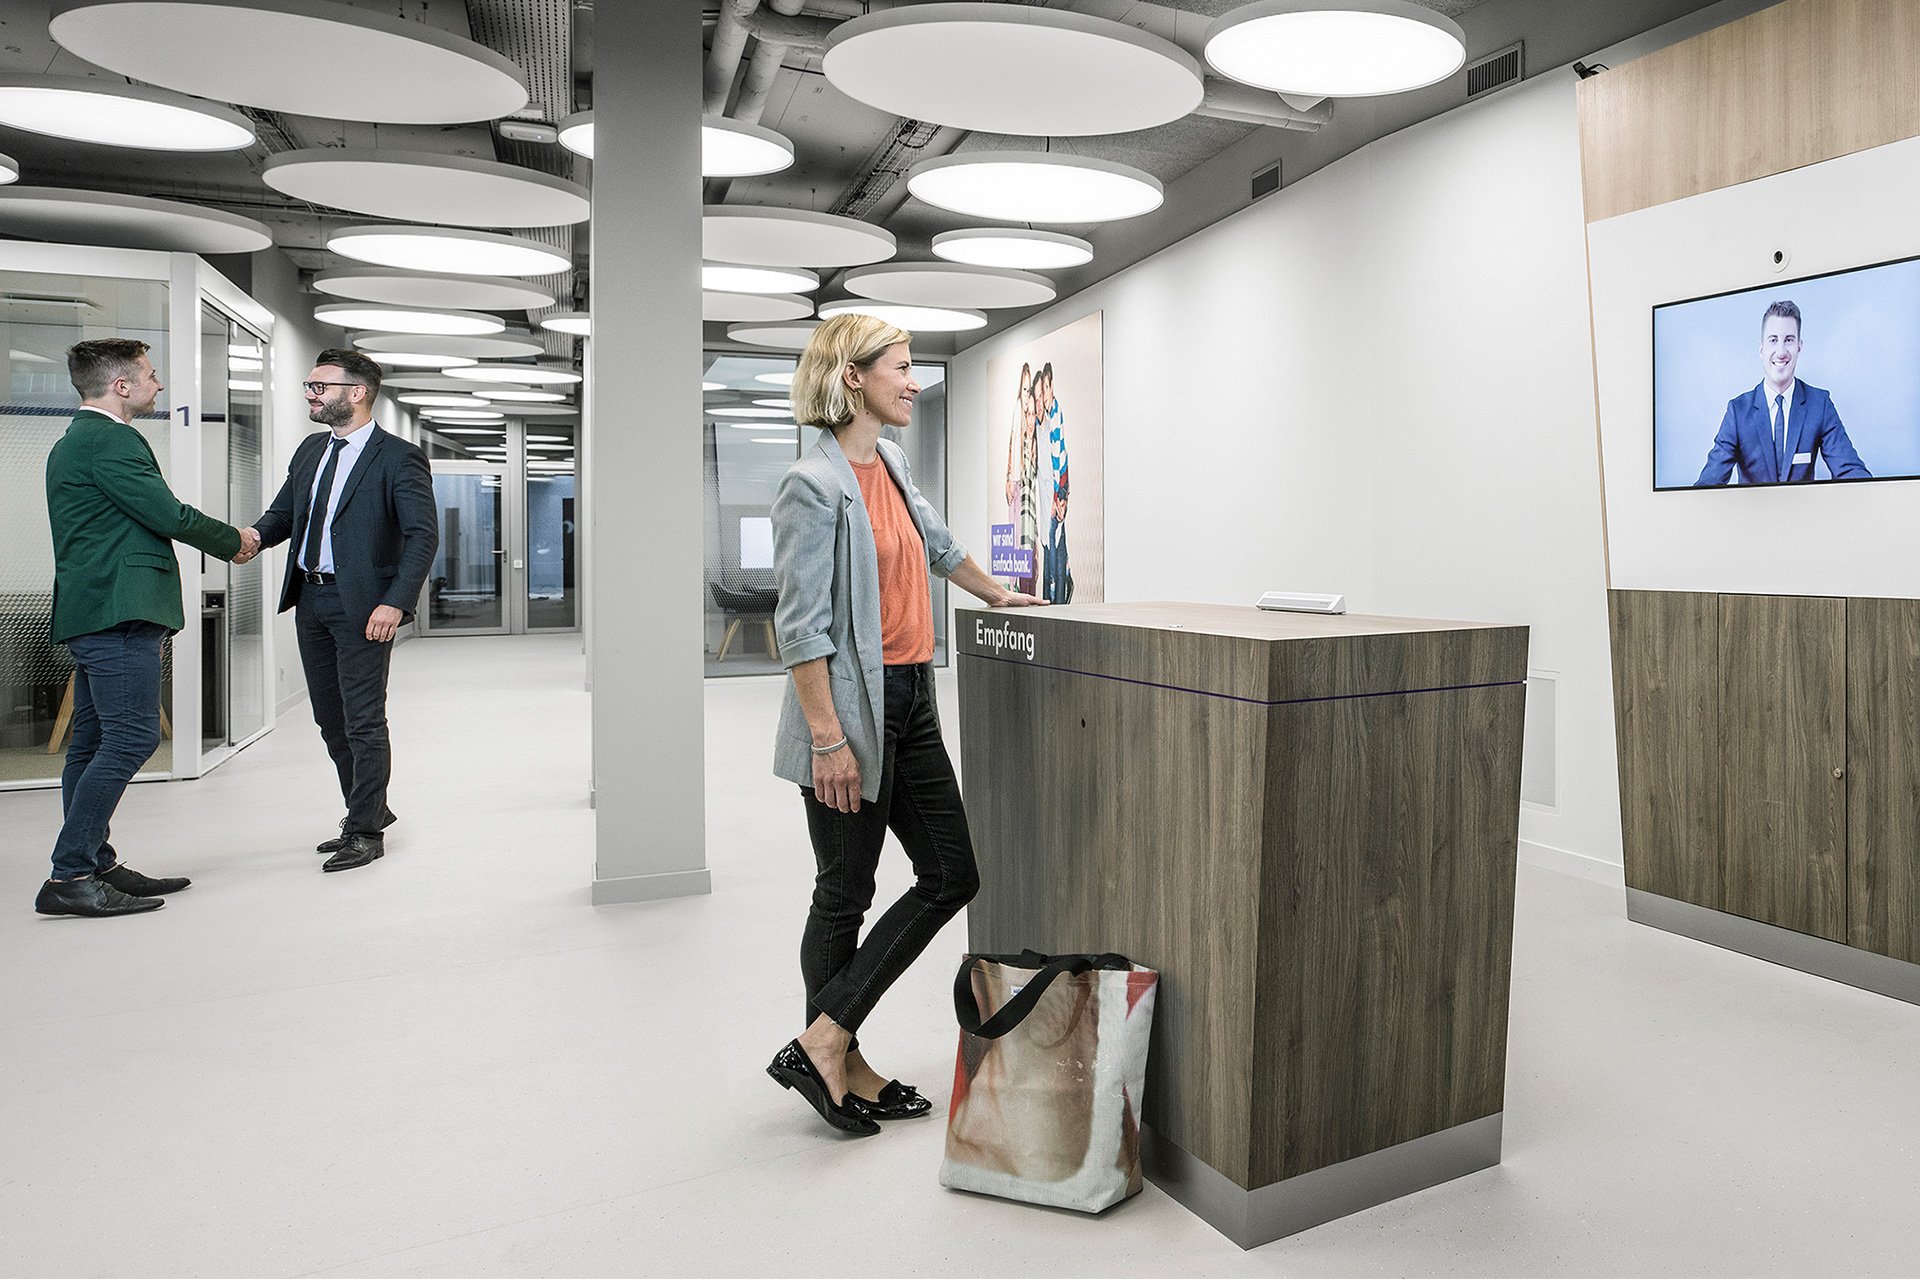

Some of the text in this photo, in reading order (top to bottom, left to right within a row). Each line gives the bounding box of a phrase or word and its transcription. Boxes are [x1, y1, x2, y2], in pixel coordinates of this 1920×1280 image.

[176, 406, 189, 426] 1
[993, 527, 1014, 547] wir sind
[993, 553, 1031, 573] einfach bank.
[976, 618, 1035, 661] Empfang
